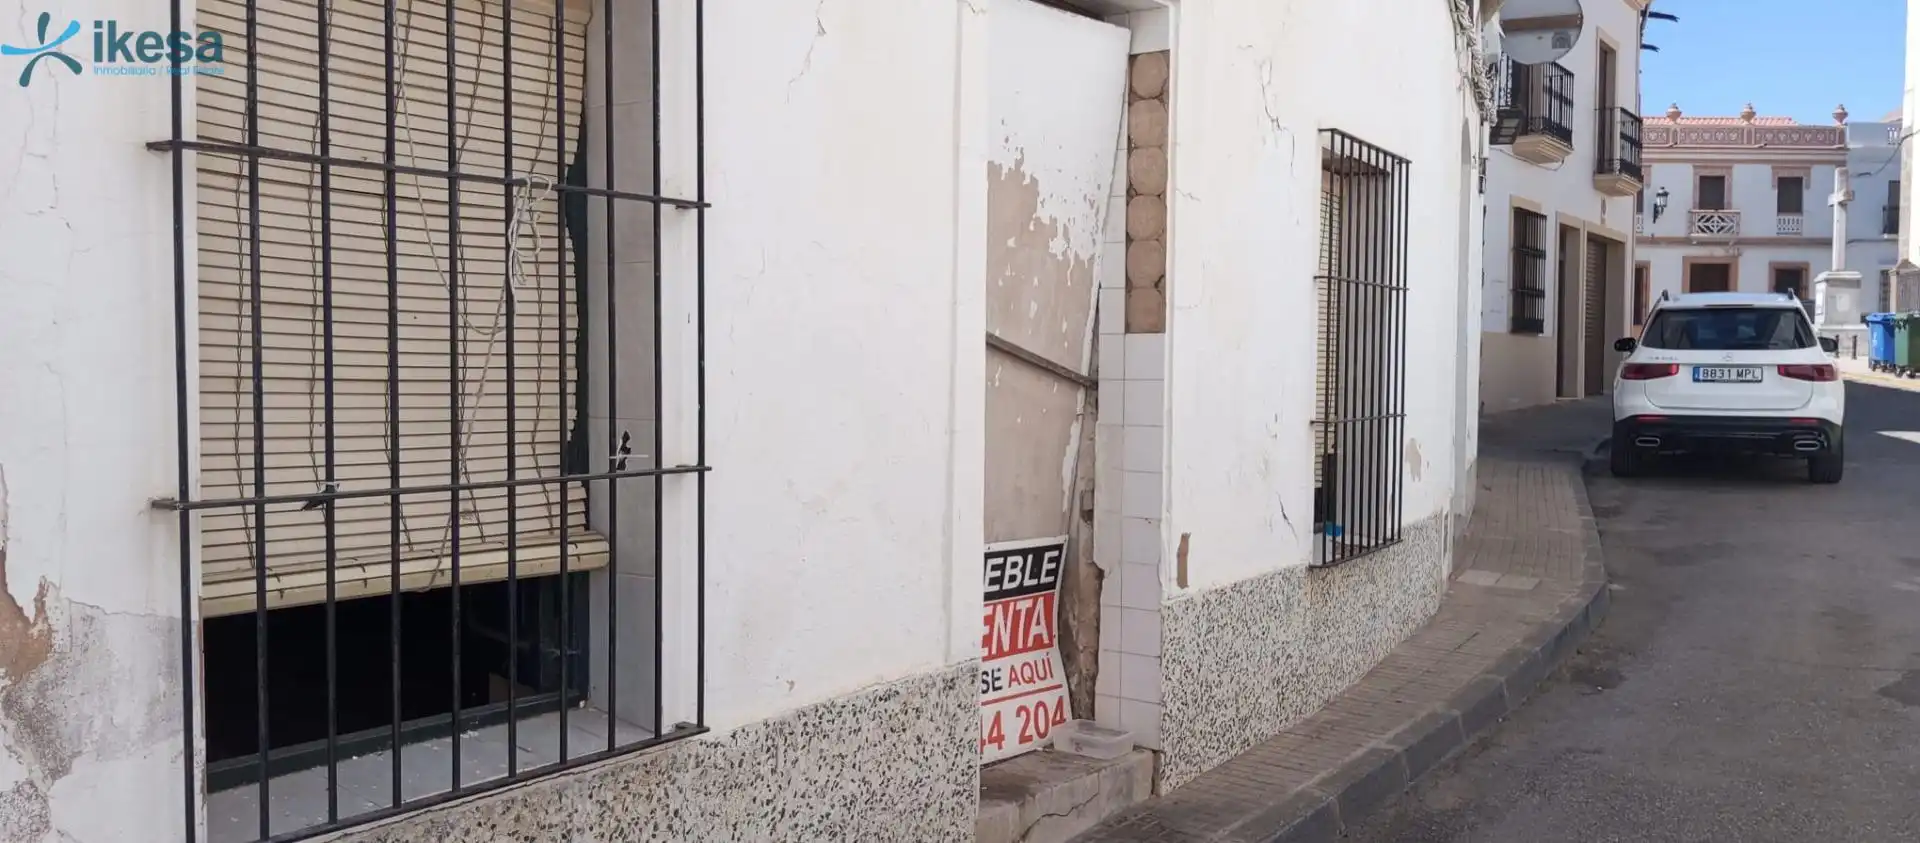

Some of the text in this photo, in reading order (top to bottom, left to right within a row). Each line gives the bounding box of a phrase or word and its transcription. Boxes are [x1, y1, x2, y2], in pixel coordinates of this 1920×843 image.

[1702, 368, 1759, 379] 8831 MPL
[984, 549, 1060, 592] EBLE
[980, 652, 1054, 695] SE AQUÍ
[1016, 695, 1067, 745] 204
